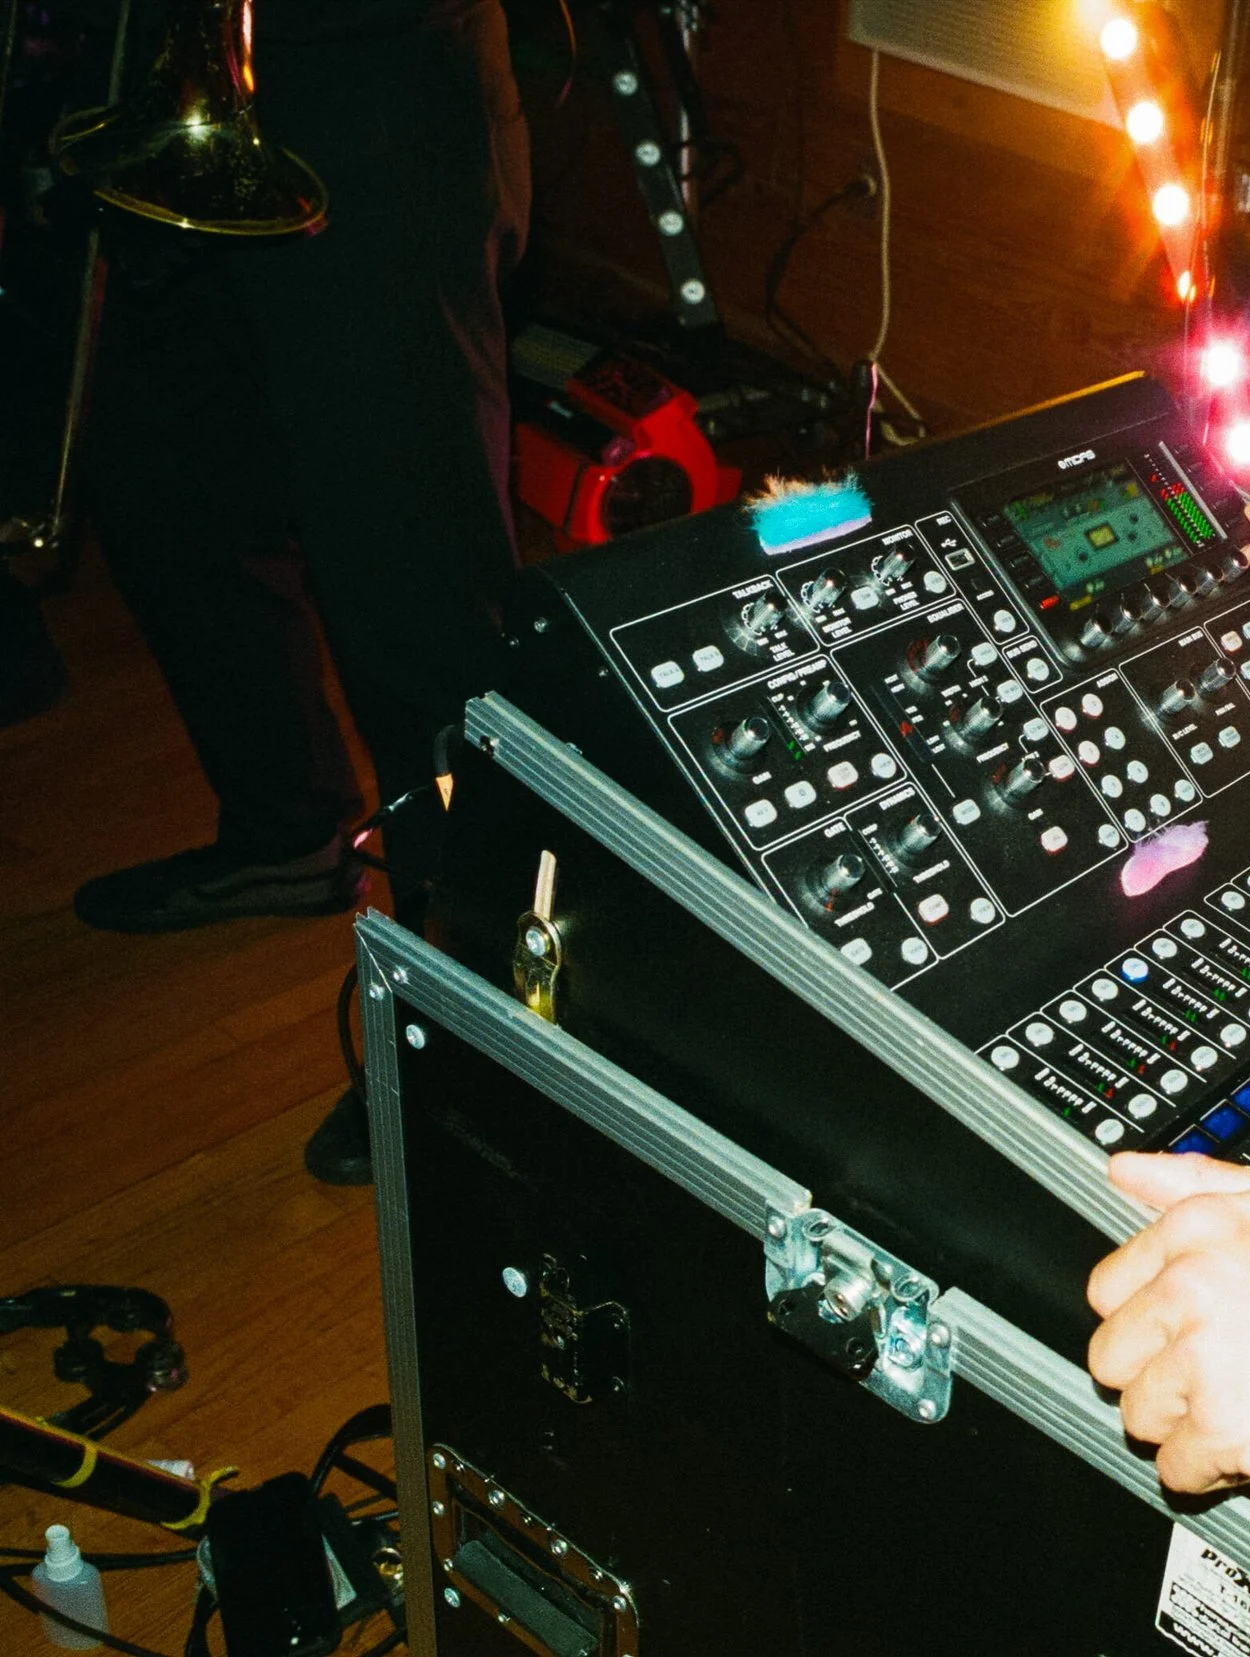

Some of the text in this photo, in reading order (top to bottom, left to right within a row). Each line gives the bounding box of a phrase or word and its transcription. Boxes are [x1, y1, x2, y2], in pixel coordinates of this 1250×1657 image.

[936, 515, 952, 525] REC
[881, 529, 913, 545] MONITOR
[732, 580, 774, 599] TALKBACK
[900, 599, 919, 610] LEVEL
[831, 627, 853, 638] LEVEL
[770, 642, 788, 653] TALK
[774, 649, 796, 662] LEVEL
[879, 786, 916, 811] DYNAMICS
[824, 821, 847, 838] GATE
